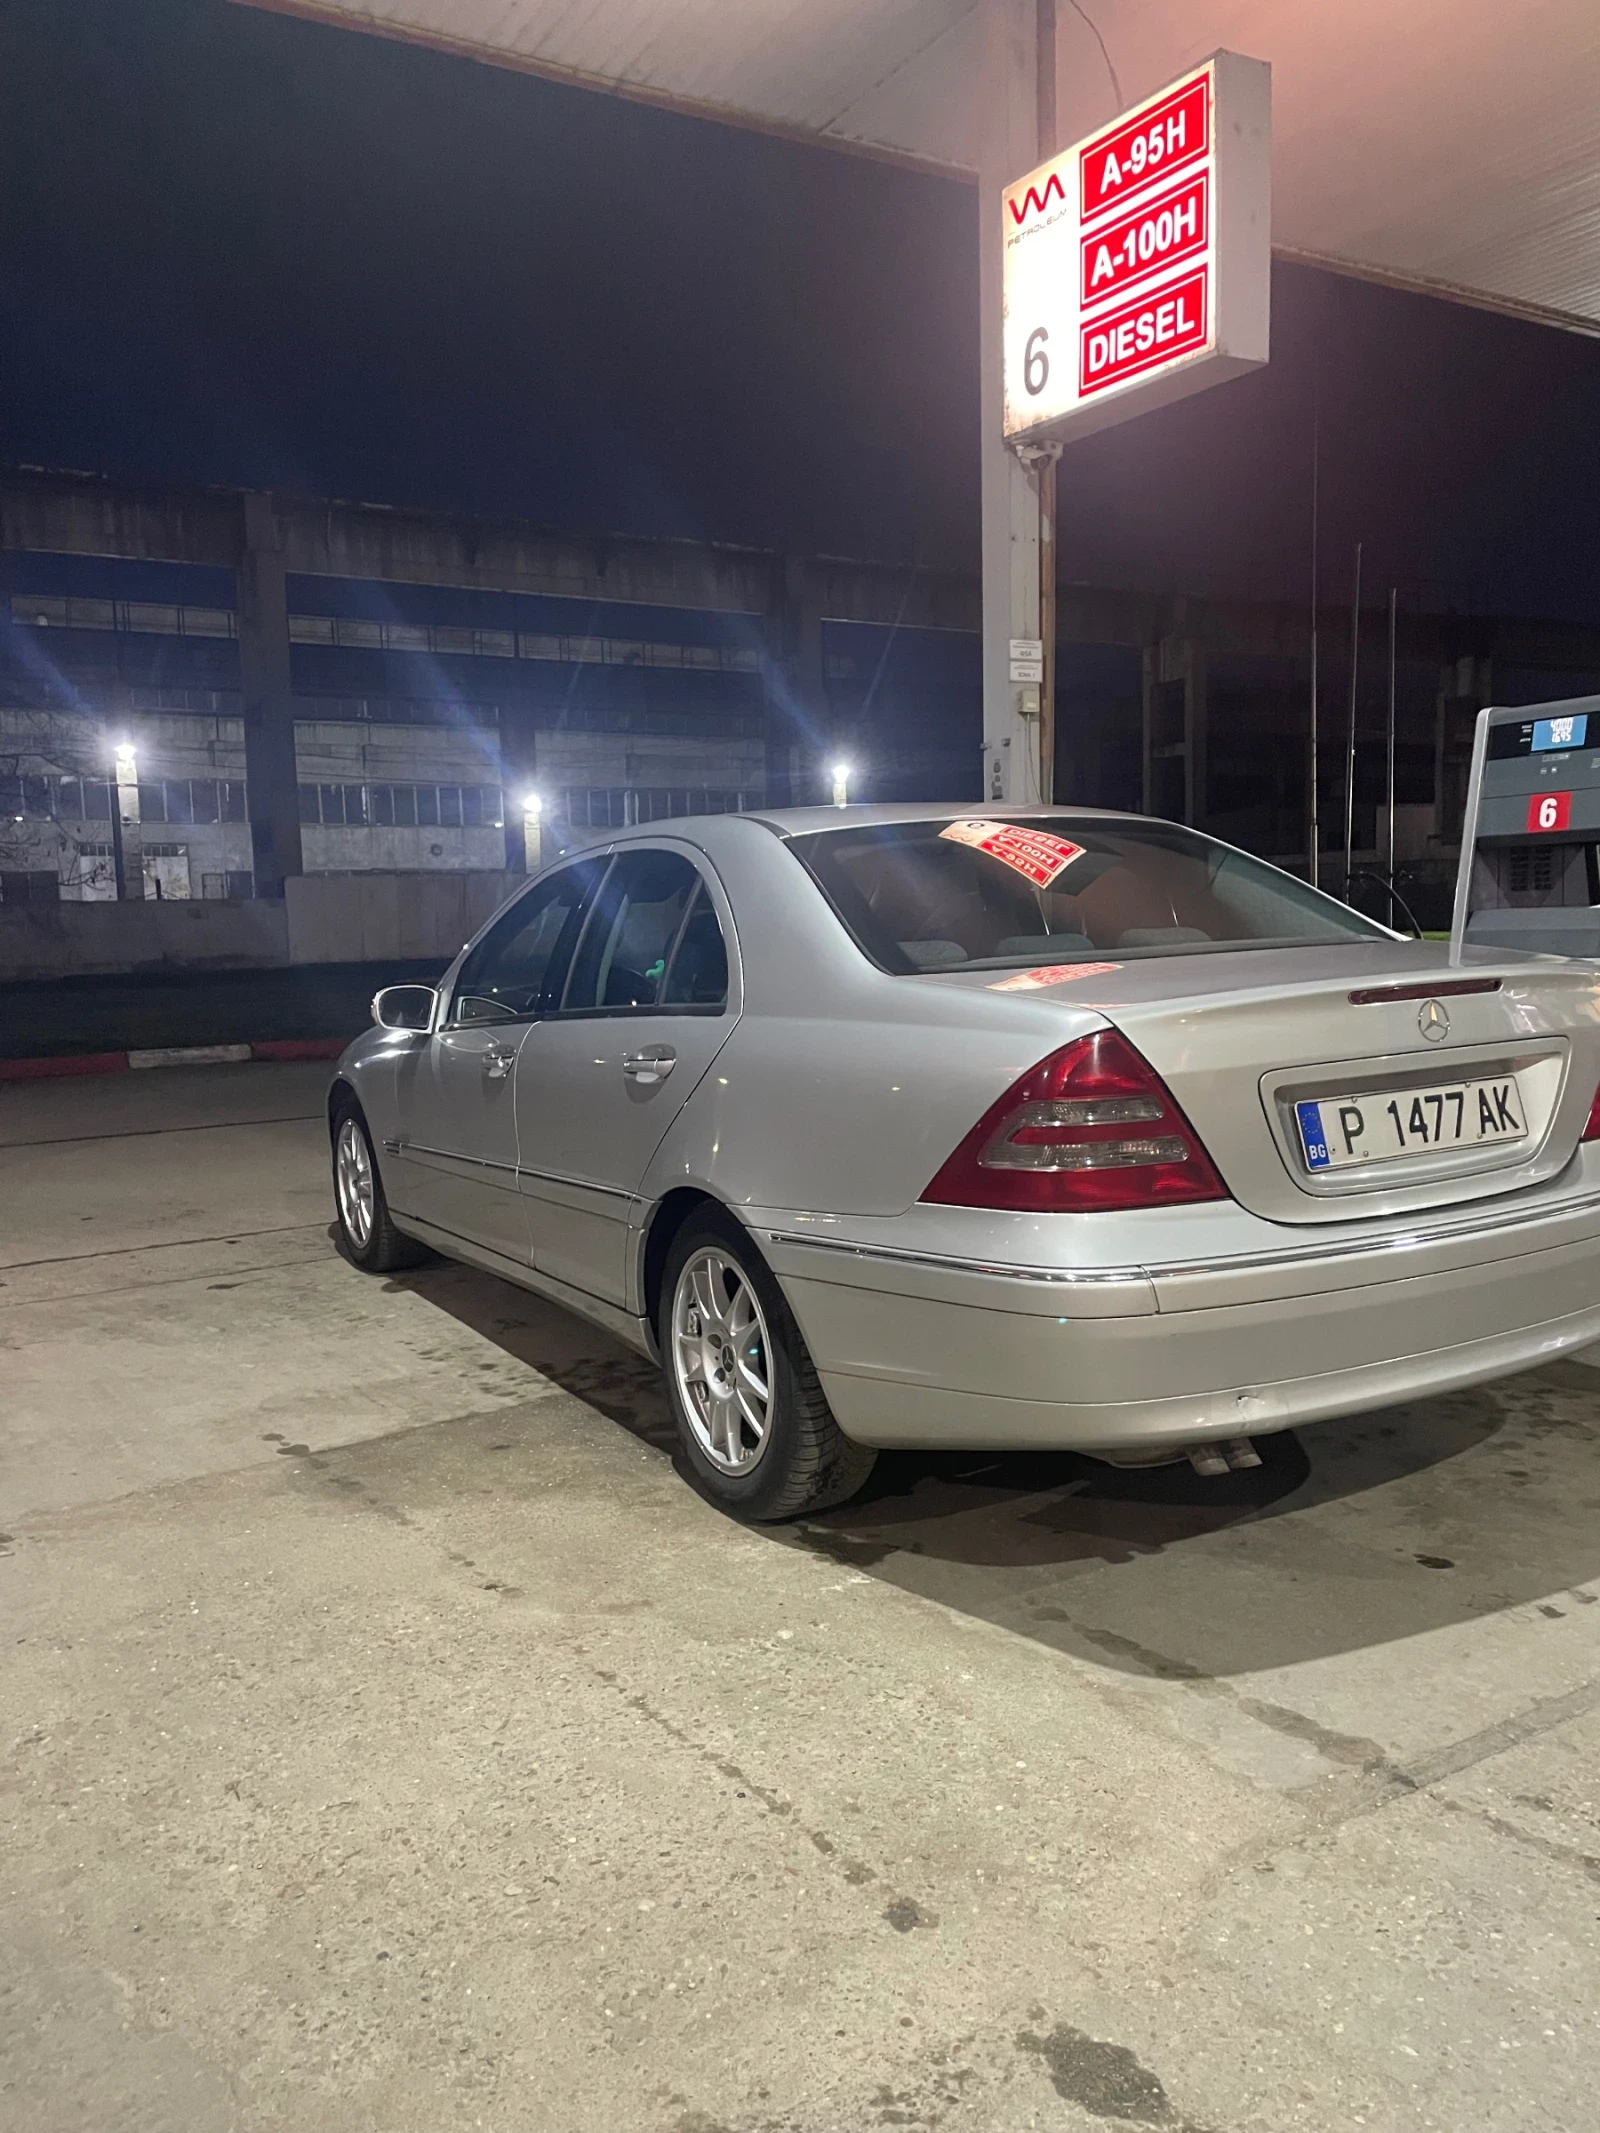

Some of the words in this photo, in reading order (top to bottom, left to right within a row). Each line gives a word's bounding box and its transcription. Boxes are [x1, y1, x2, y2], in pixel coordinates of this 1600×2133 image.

[1099, 109, 1186, 194] A-95H
[1090, 196, 1196, 287] A-100H
[1023, 326, 1050, 397] 6
[1089, 297, 1195, 373] DIESEL
[1539, 797, 1558, 828] 6
[1308, 1143, 1327, 1160] BG
[1338, 1106, 1365, 1155] P
[1387, 1091, 1464, 1147] 1477
[1478, 1084, 1520, 1135] AK
